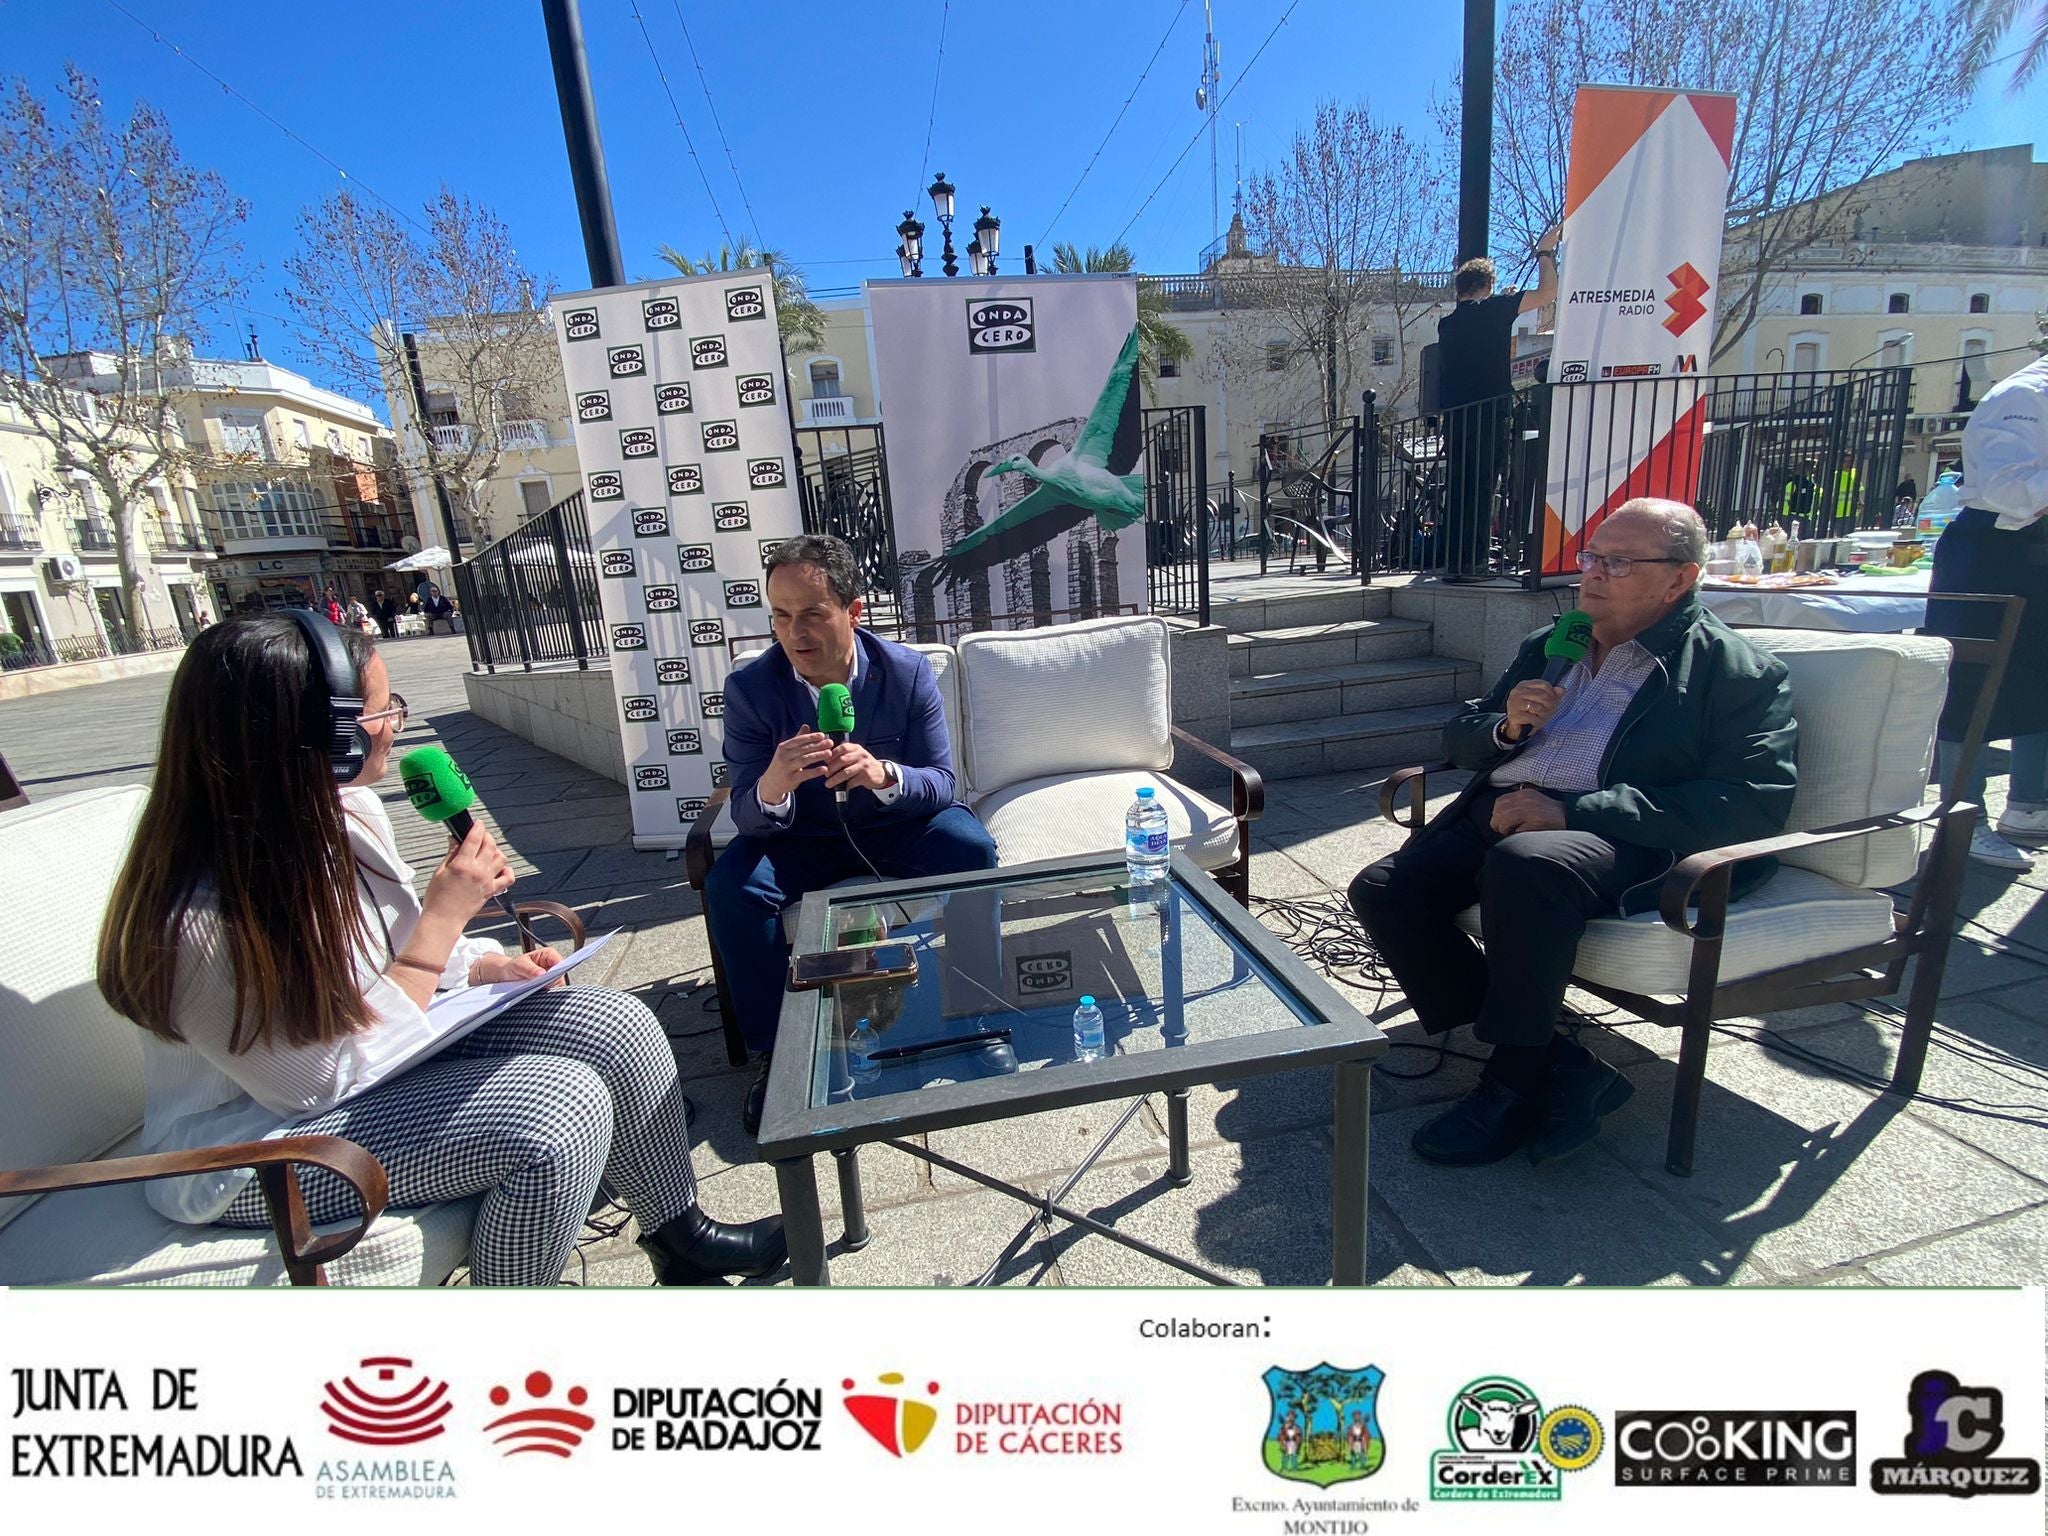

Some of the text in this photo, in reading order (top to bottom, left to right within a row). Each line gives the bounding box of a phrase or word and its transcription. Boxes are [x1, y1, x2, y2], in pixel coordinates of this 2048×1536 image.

[731, 293, 757, 303] ONDA
[1569, 289, 1655, 304] ATRESMEDIA
[648, 304, 673, 314] ONDA
[734, 305, 758, 315] CERO
[1618, 305, 1655, 316] RADIO
[569, 315, 593, 324] ONDA
[651, 316, 675, 325] CERO
[978, 310, 1023, 322] ONDA
[572, 326, 594, 335] CERO
[981, 330, 1024, 343] CERO
[695, 342, 720, 351] ONDA
[613, 351, 638, 360] ONDA
[698, 353, 721, 363] CERO
[616, 363, 640, 372] CERO
[1565, 365, 1585, 373] ONDA
[1565, 374, 1584, 383] CERO
[742, 380, 768, 389] ONDA
[660, 389, 685, 397] ONDA
[745, 391, 769, 401] CERO
[581, 397, 605, 406] ONDA
[663, 400, 686, 409] CERO
[584, 408, 606, 417] CERO
[707, 426, 731, 435] ONDA
[625, 434, 650, 442] ONDA
[710, 437, 733, 446] CERO
[628, 445, 651, 453] CERO
[753, 464, 779, 472] ONDA
[672, 470, 696, 479] ONDA
[594, 477, 617, 485] ONDA
[756, 475, 780, 484] CERO
[675, 481, 698, 490] CERO
[597, 487, 618, 496] CERO
[637, 513, 662, 521] ONDA
[721, 518, 744, 527] CERO
[640, 524, 663, 532] CERO
[686, 560, 709, 568] CERO
[608, 565, 630, 573] CERO
[729, 585, 754, 593] ONDA
[652, 600, 675, 608] CERO
[619, 638, 641, 646] CERO
[696, 634, 719, 642] CERO
[682, 801, 705, 809] ONDA
